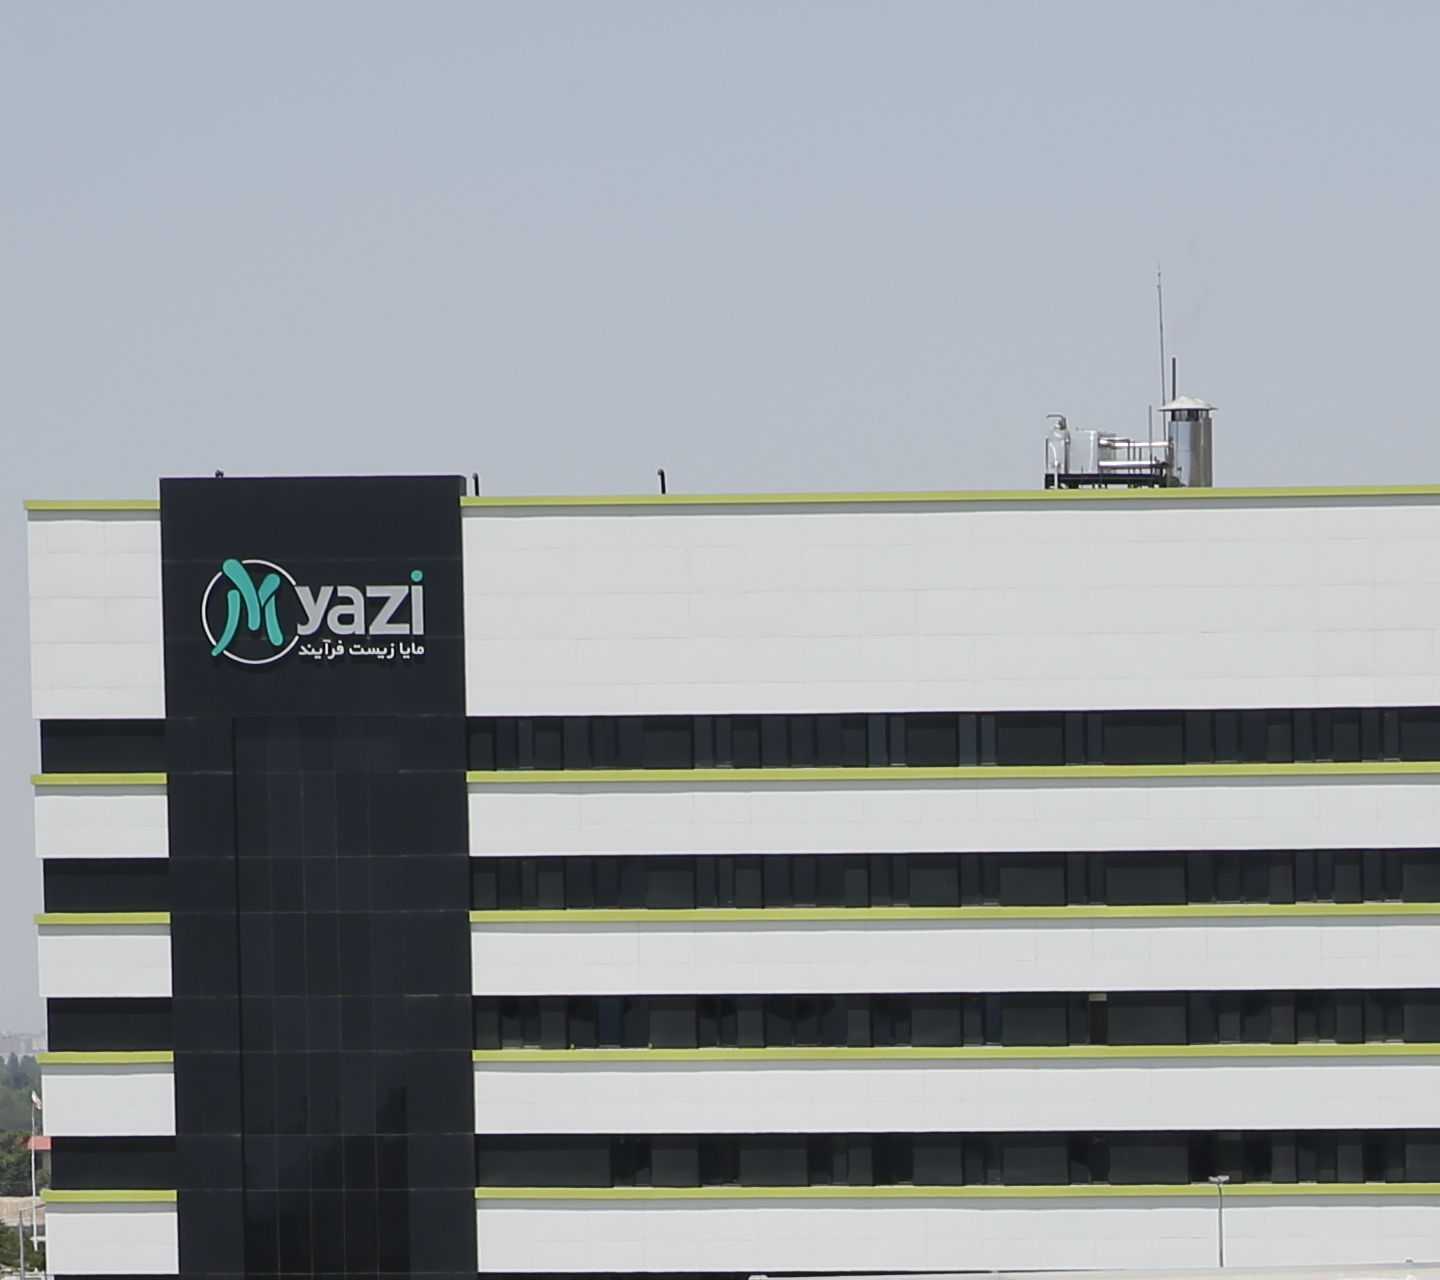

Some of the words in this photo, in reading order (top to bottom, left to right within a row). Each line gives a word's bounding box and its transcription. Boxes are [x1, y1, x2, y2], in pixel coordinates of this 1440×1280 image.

[298, 639, 345, 660] فرآیند
[349, 642, 395, 660] زیست
[399, 642, 425, 659] مایا
